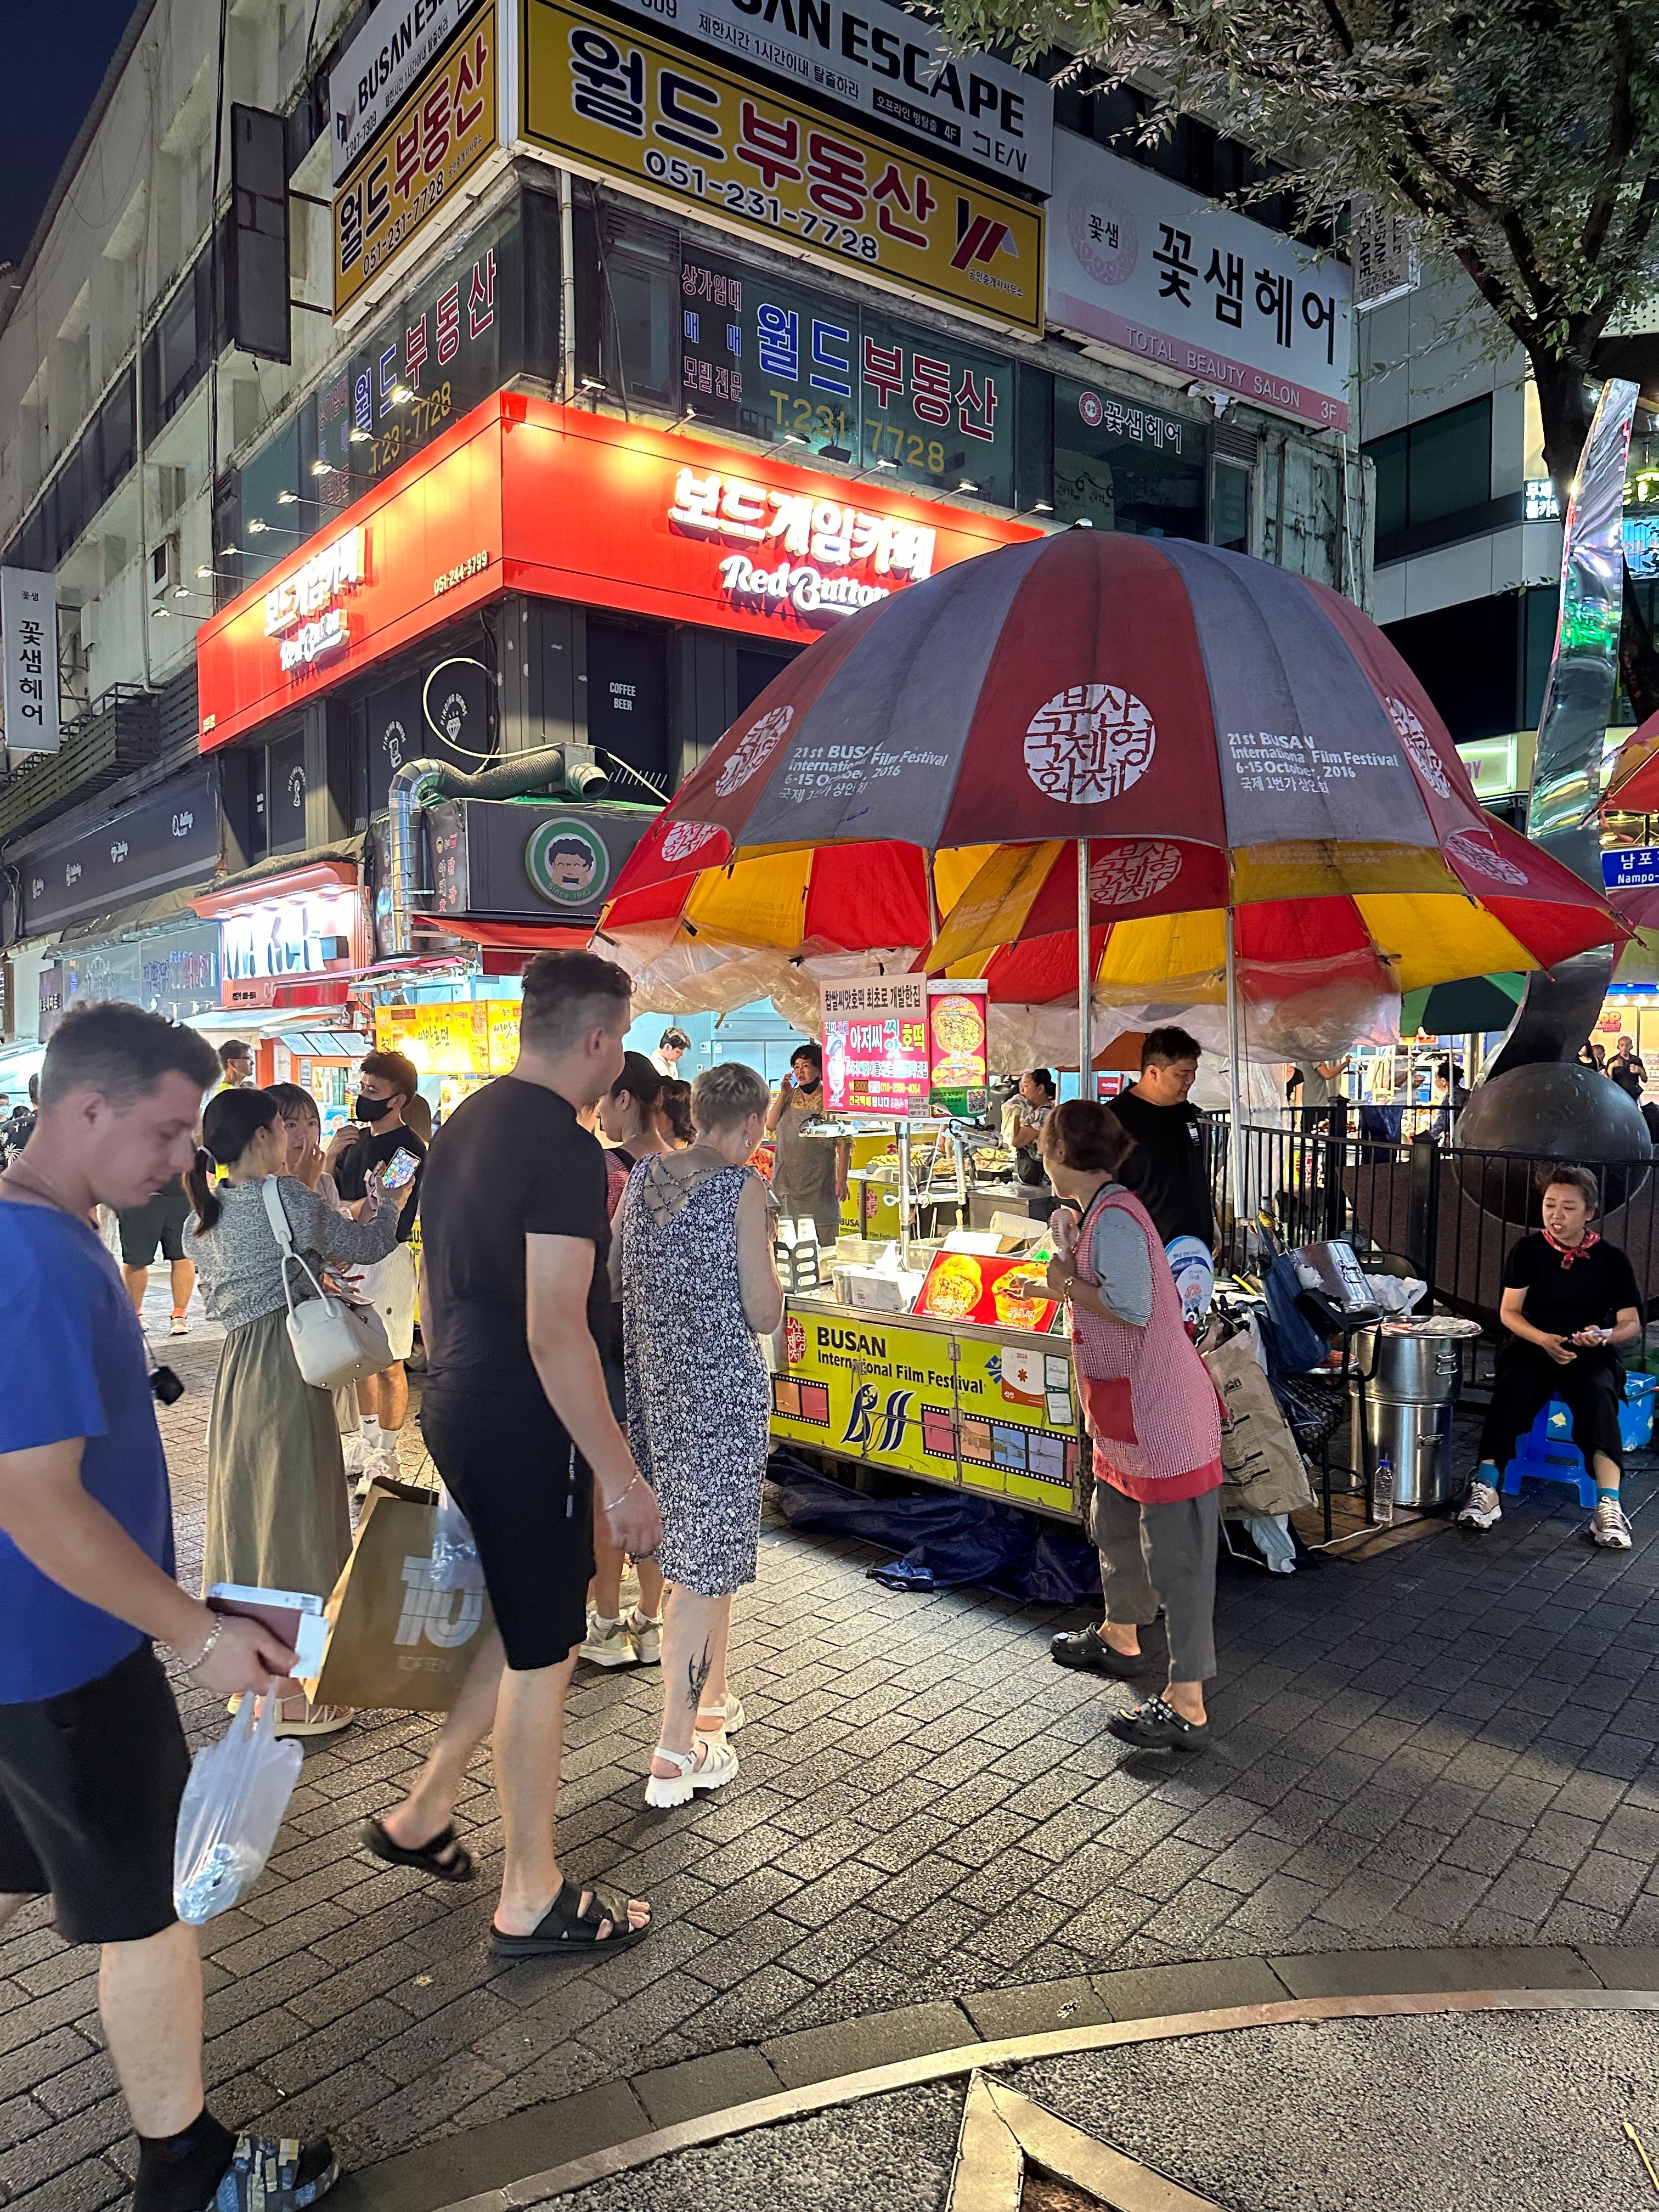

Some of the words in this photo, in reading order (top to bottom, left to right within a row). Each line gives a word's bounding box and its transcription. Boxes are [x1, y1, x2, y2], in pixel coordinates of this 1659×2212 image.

[358, 13, 411, 115] BUSAN
[698, 14, 749, 50] 제한시간
[755, 40, 809, 77] 1시간이내
[814, 64, 860, 100] 탈출하라
[842, 11, 1024, 138] ESCAPE
[877, 96, 910, 120] 오프라인
[913, 111, 937, 133] 방탈출
[944, 126, 957, 141] 4F
[341, 32, 487, 275] 월드부동산
[568, 26, 937, 250] 월드부동산
[995, 140, 1027, 173] E/V
[644, 148, 879, 262] 051-231-7728
[363, 171, 444, 276] 051-231-7728
[1087, 214, 1119, 250] 꽃샘
[681, 264, 742, 312] 상가임대
[1152, 223, 1336, 365] 꽃샘헤어
[757, 302, 997, 443] 월드부동산
[1126, 327, 1177, 364] TOTAL
[1187, 349, 1246, 387] BEAUTY
[1253, 376, 1300, 408] SALON
[1321, 400, 1338, 421] 3F
[1104, 400, 1182, 454] 꽃샘헤어
[667, 466, 936, 583] 보드게임카페
[433, 549, 488, 596] 051-244-3799
[719, 555, 791, 599] Red
[21, 590, 39, 602] 꽃샘
[19, 620, 44, 726] 꽃샘헤어
[610, 681, 636, 698] COFFEE
[613, 697, 633, 712] BEER
[793, 746, 824, 759] 21st
[1227, 733, 1257, 745] 21st
[785, 773, 814, 786] 6-15
[871, 765, 901, 778] 2016
[870, 752, 899, 766] Film
[899, 750, 949, 767] Festival
[1236, 761, 1263, 774] 6-15
[1323, 766, 1357, 778] 2016
[1312, 749, 1343, 764] Film
[1344, 752, 1399, 768] Festival
[1240, 776, 1265, 792] 국제
[1266, 776, 1297, 792] 1번가
[1621, 851, 1659, 870] 남포
[574, 888, 591, 899] 1983
[825, 989, 865, 1012] 찹쌀씨앗호떡
[867, 987, 889, 1010] 최초로
[890, 984, 921, 1009] 개발한집
[850, 1023, 883, 1054] 아저씨
[817, 1325, 886, 1358] BUSAN
[896, 1365, 924, 1385] Film
[928, 1372, 984, 1396] Festival
